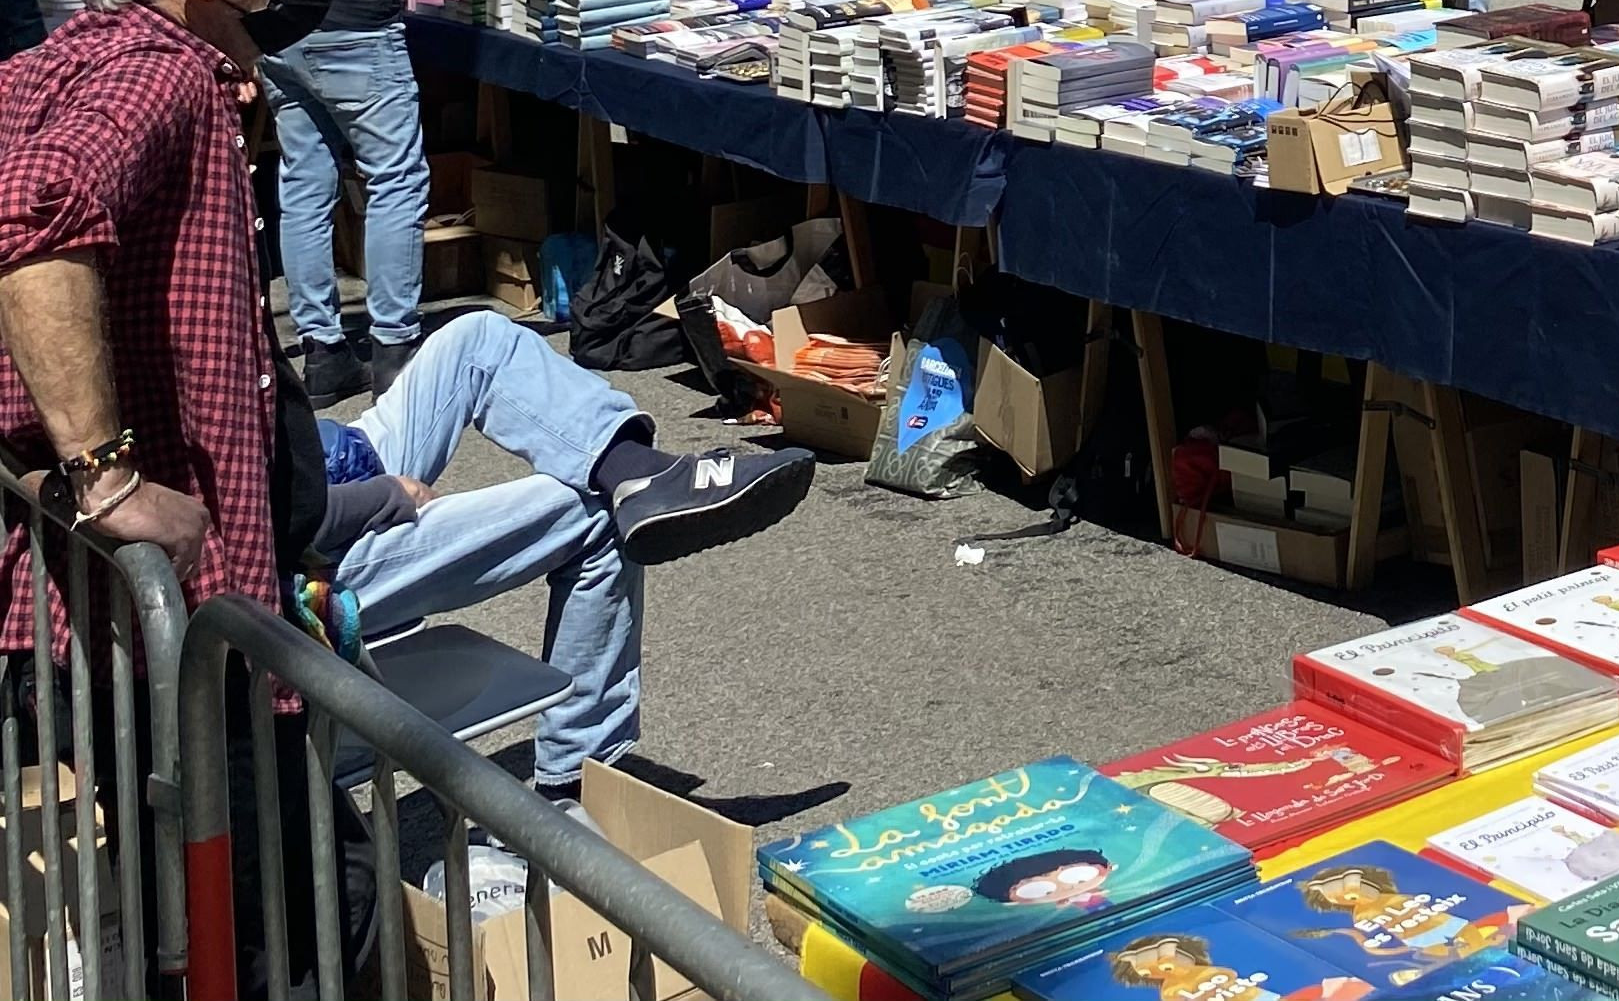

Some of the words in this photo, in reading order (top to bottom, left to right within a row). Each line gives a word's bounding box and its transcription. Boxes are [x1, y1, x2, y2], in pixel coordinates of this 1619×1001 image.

[694, 456, 735, 489] N
[1503, 601, 1518, 613] El
[1334, 649, 1359, 661] El
[1360, 622, 1461, 653] Principito
[1568, 770, 1587, 781] El
[831, 823, 920, 858] La
[1460, 840, 1479, 850] El
[1480, 810, 1556, 847] Principito
[919, 849, 998, 878] MIRIAM
[1001, 823, 1075, 855] TIRADO
[470, 884, 526, 908] enera
[1354, 914, 1393, 933] En
[1391, 894, 1432, 916] Leo
[1364, 933, 1393, 949] es
[1388, 893, 1468, 936] vesteix
[1559, 915, 1588, 929] La
[587, 931, 612, 961] M
[1525, 926, 1552, 950] Jordi
[1555, 939, 1578, 962] Sant
[1580, 952, 1595, 968] de
[1179, 974, 1229, 999] Leo
